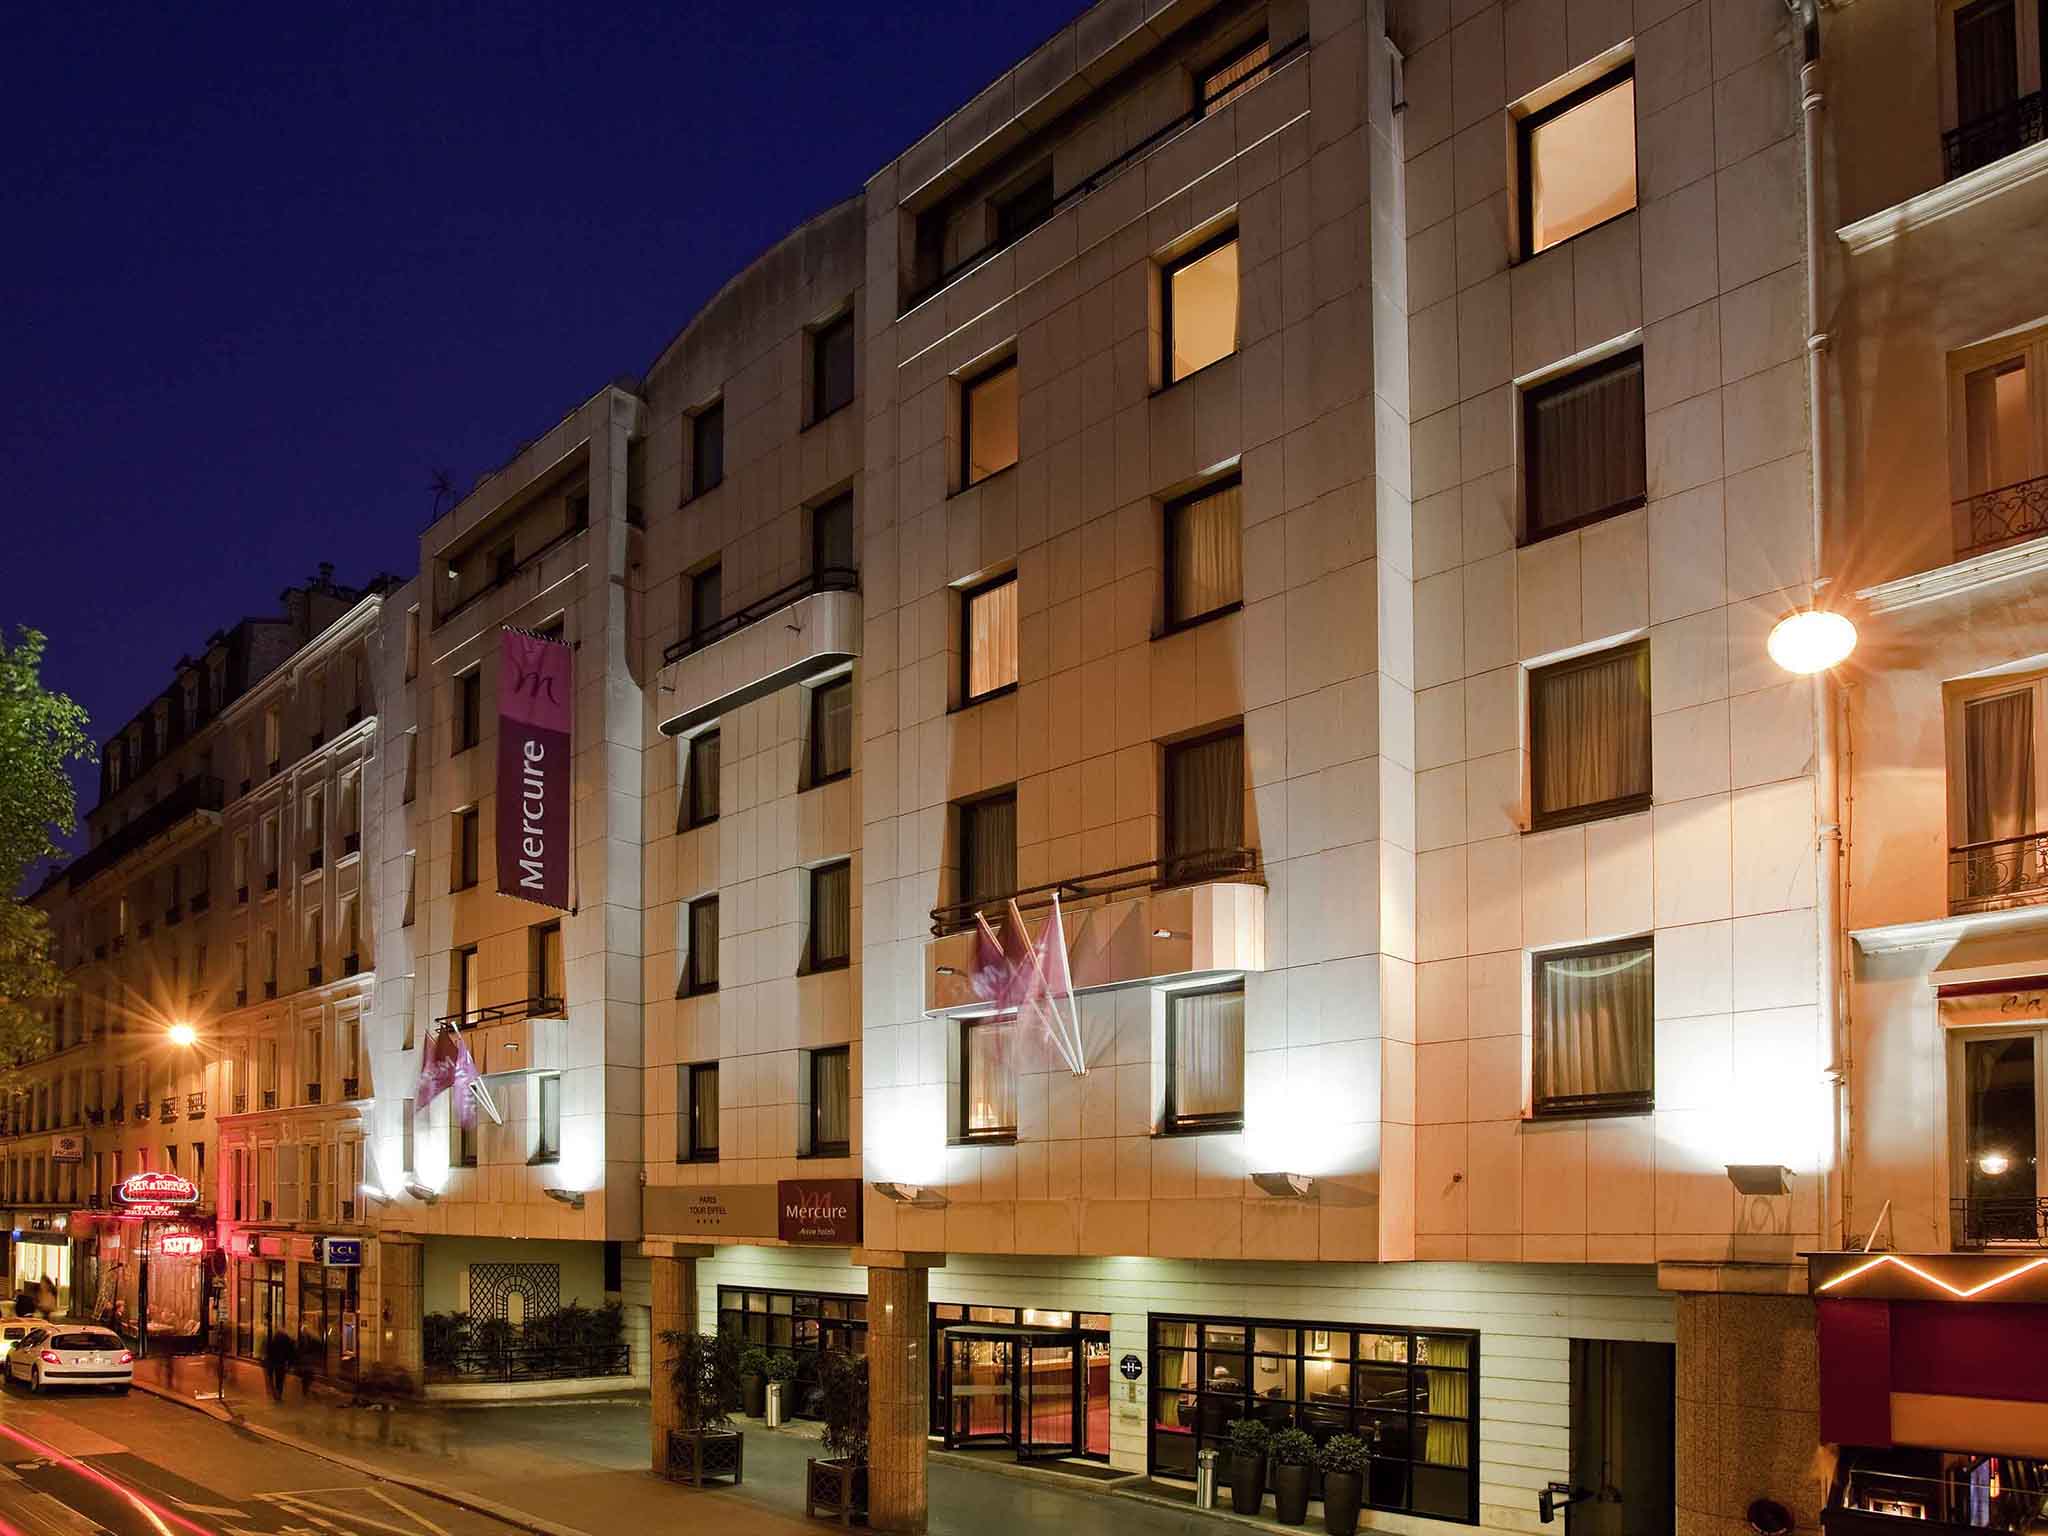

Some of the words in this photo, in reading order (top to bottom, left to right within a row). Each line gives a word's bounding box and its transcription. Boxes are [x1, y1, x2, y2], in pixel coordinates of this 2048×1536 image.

[520, 740, 544, 890] Mercure
[699, 1196, 717, 1204] PARIS
[689, 1206, 705, 1215] TOUR
[707, 1206, 728, 1215] EIFFEL
[786, 1204, 847, 1218] Mercure
[330, 1246, 354, 1255] LCL
